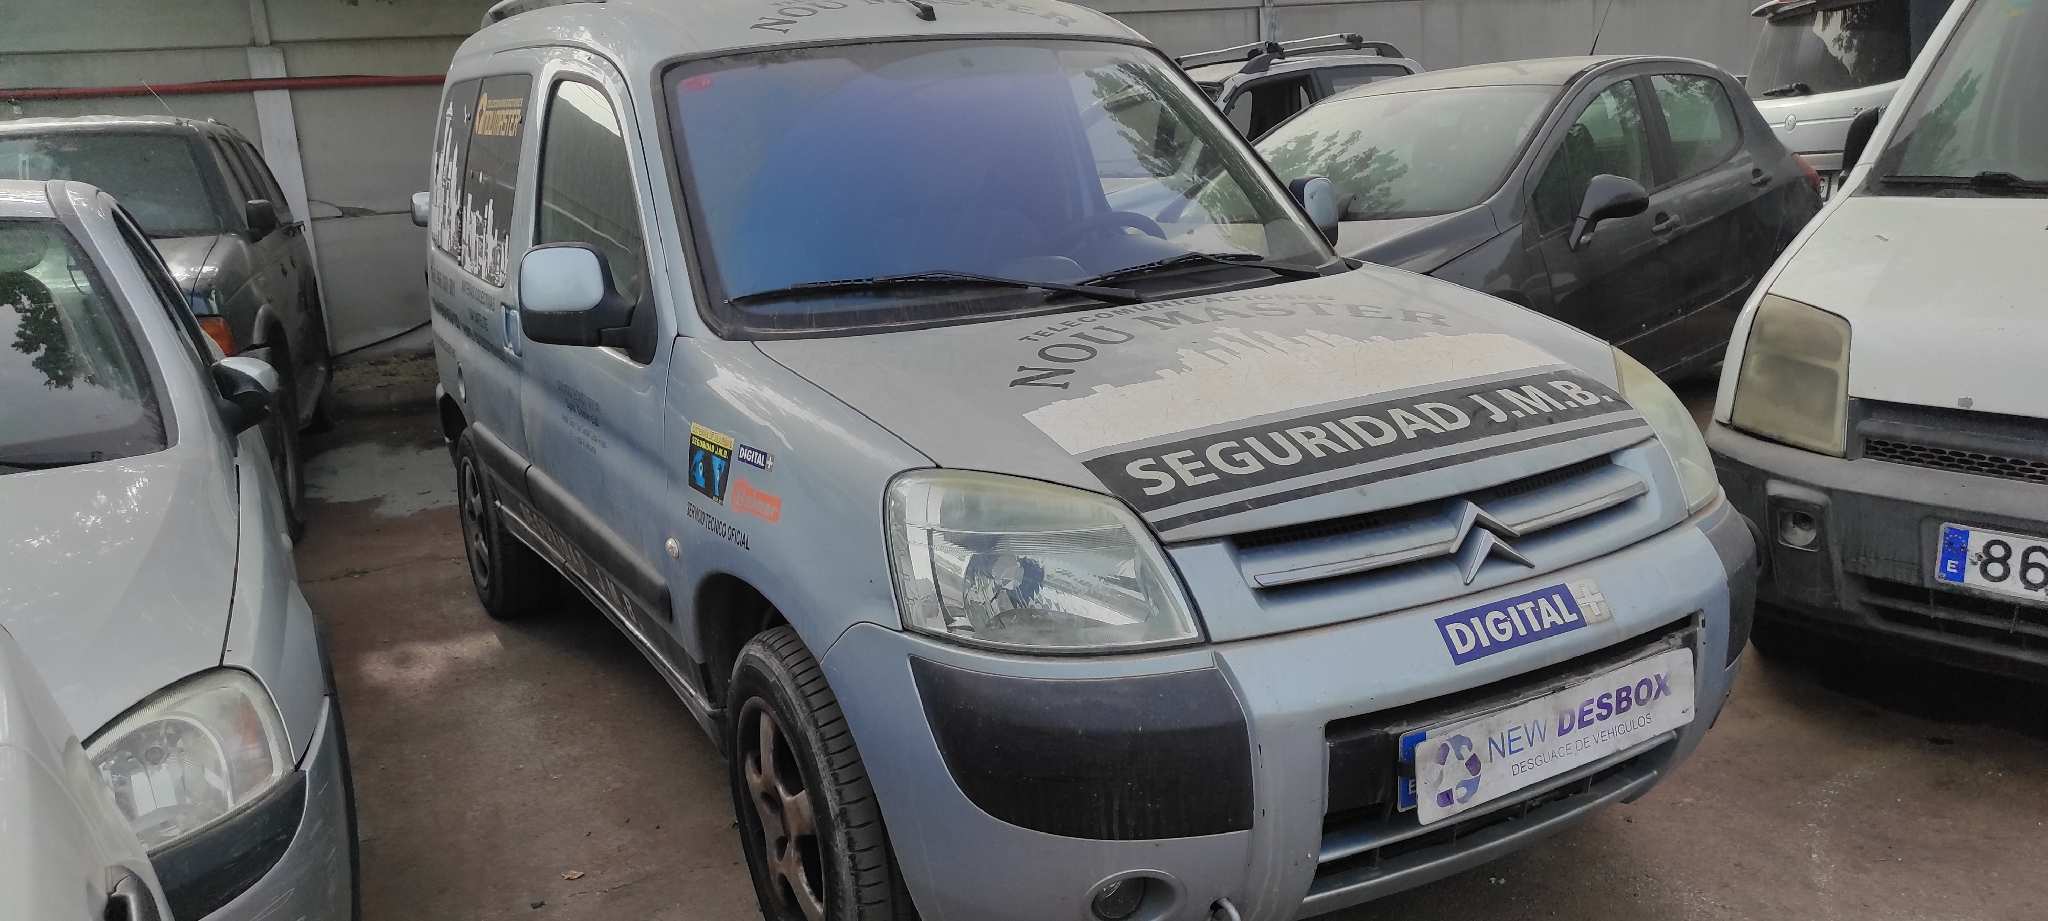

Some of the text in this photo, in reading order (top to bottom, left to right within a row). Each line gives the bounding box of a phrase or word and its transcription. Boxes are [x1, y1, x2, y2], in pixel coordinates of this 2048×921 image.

[1009, 302, 1452, 389] NOU MASTER
[739, 446, 766, 467] DIGITAL
[1125, 380, 1614, 496] SEGURIDAD J.M.B.
[1946, 559, 1959, 573] E
[1445, 592, 1579, 656] DIGITAL
[1487, 671, 1673, 764] NEW DESBOX
[1511, 712, 1653, 777] DESGUACE DE VEHICULOS
